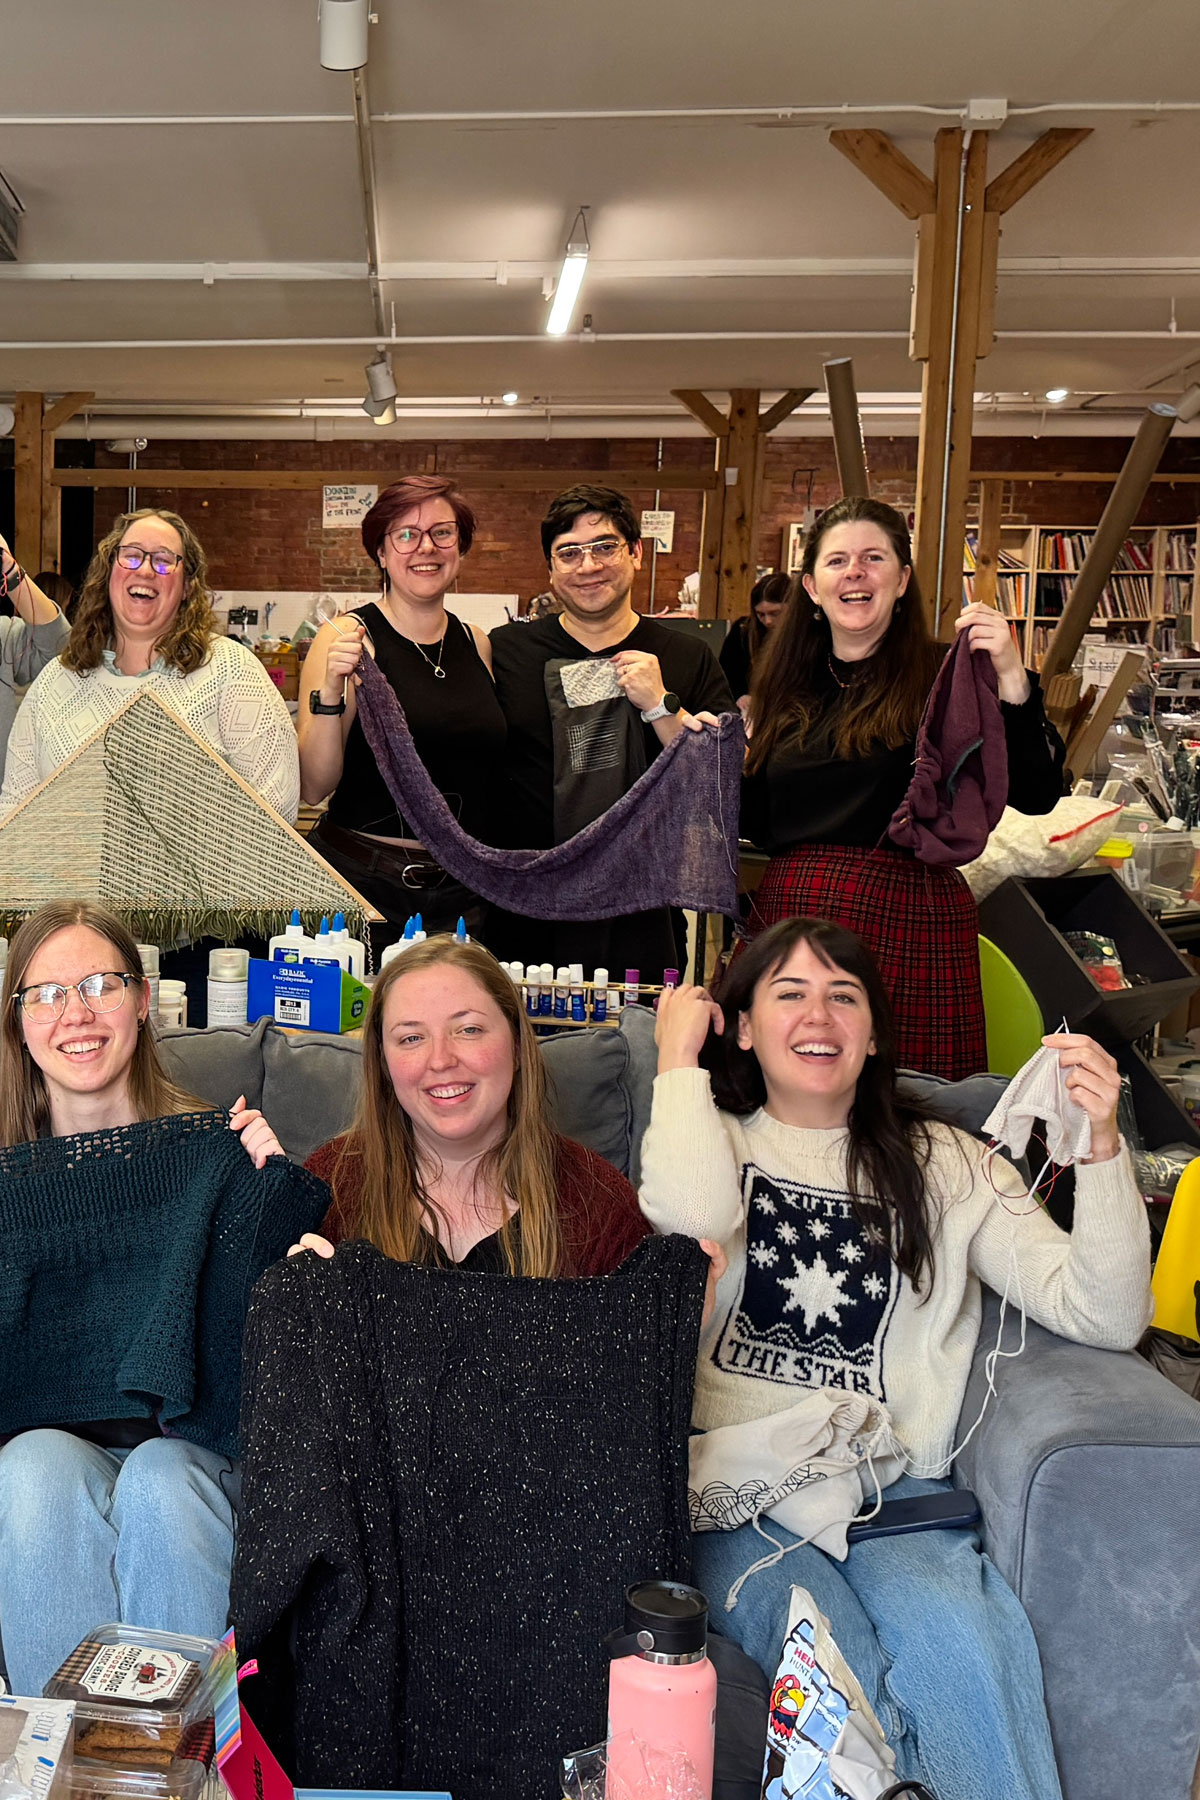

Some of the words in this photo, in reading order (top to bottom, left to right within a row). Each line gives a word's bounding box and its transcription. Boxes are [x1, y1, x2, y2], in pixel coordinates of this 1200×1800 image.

[727, 1339, 787, 1377] THE
[793, 1355, 871, 1394] STAR
[118, 1647, 143, 1671] COVERED
[104, 1670, 128, 1692] BRIDGE
